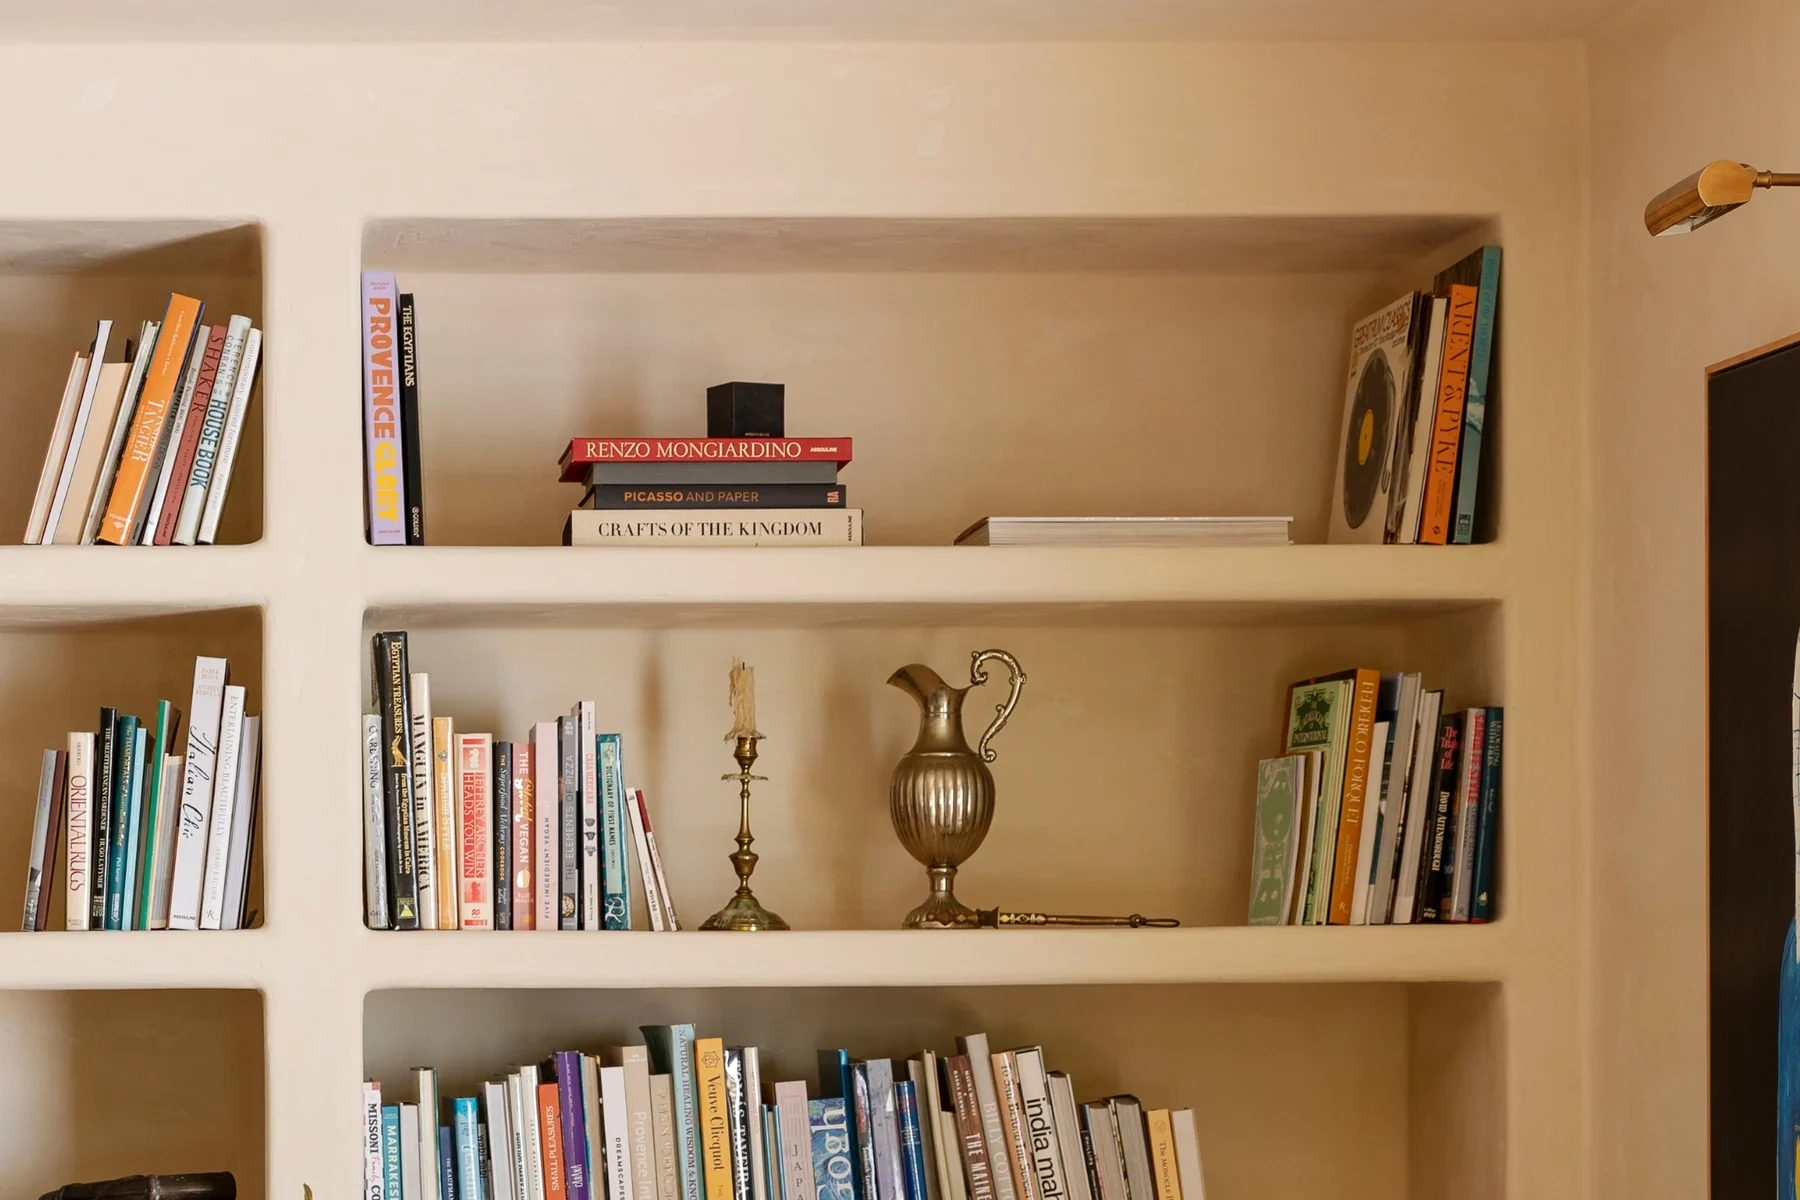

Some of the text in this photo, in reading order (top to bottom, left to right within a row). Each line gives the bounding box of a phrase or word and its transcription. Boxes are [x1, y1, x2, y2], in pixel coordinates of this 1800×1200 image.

[224, 336, 243, 387] TERENCE
[402, 305, 414, 386] THE EGYPTIANS
[1446, 292, 1473, 380] ARENT
[191, 334, 223, 415] SHAKER
[1443, 384, 1462, 404] &
[221, 338, 256, 463] contemporary painted furniture
[369, 296, 399, 521] PROVENCE GLORY
[130, 396, 165, 464] TANGIER
[147, 415, 164, 450] INSIDE
[189, 398, 227, 489] HOUSE BOOK
[585, 441, 800, 458] RENZO MONGIARDINO
[1434, 408, 1459, 474] PYKE
[624, 491, 758, 500] PICASSO AND PAPER
[598, 522, 822, 536] CRAFTS OF THE KINGDOM
[390, 641, 403, 733] EGYPTIAN TREASURES
[1356, 681, 1374, 753] FEDERICO
[101, 742, 110, 794] MEDITERRANEAN
[121, 737, 131, 783] IMMORTALS
[182, 725, 216, 839] Italian Chic
[215, 695, 238, 836] ENTERTAINING BEAUTIFULLY
[519, 751, 528, 774] THE
[585, 753, 593, 803] CASA MEXICANA
[605, 766, 613, 798] DICTIONARY
[99, 796, 107, 830] GARDENER
[400, 798, 409, 824] Egyptian
[412, 713, 430, 890] MANGUIN in AMERICA
[497, 767, 507, 808] Superfood
[1346, 759, 1367, 826] FORQUET
[68, 775, 86, 890] ORIENTAL RUGS
[463, 774, 474, 876] HEADS YOU WIN
[475, 773, 486, 875] JEFFREY ARCHER
[498, 811, 507, 845] Alchemy
[519, 823, 529, 862] VEGAN
[565, 755, 574, 880] THE ELEMENTS OF PIZZA
[1430, 791, 1449, 871] DAVID ATTENBOROUGH
[678, 1029, 689, 1077] NATURAL
[657, 1087, 669, 1135] TAMSIN
[681, 1079, 692, 1125] HEALING
[706, 1075, 728, 1170] Veuve Clicquot
[981, 1101, 1005, 1146] BILLY
[1025, 1096, 1054, 1151] india
[367, 1103, 381, 1183] MISSONI Family
[477, 1134, 487, 1178] wabi sabi
[545, 1105, 559, 1190] SMALL PLEASURES
[615, 1137, 625, 1200] DREAMSCAPES
[632, 1111, 652, 1176] Provence
[685, 1126, 695, 1168] WISDOM
[964, 1132, 984, 1156] THE
[1084, 1136, 1093, 1165] PHILLIPS
[1158, 1140, 1167, 1155] The
[687, 1169, 695, 1177] &
[1160, 1157, 1172, 1193] MONOCLE
